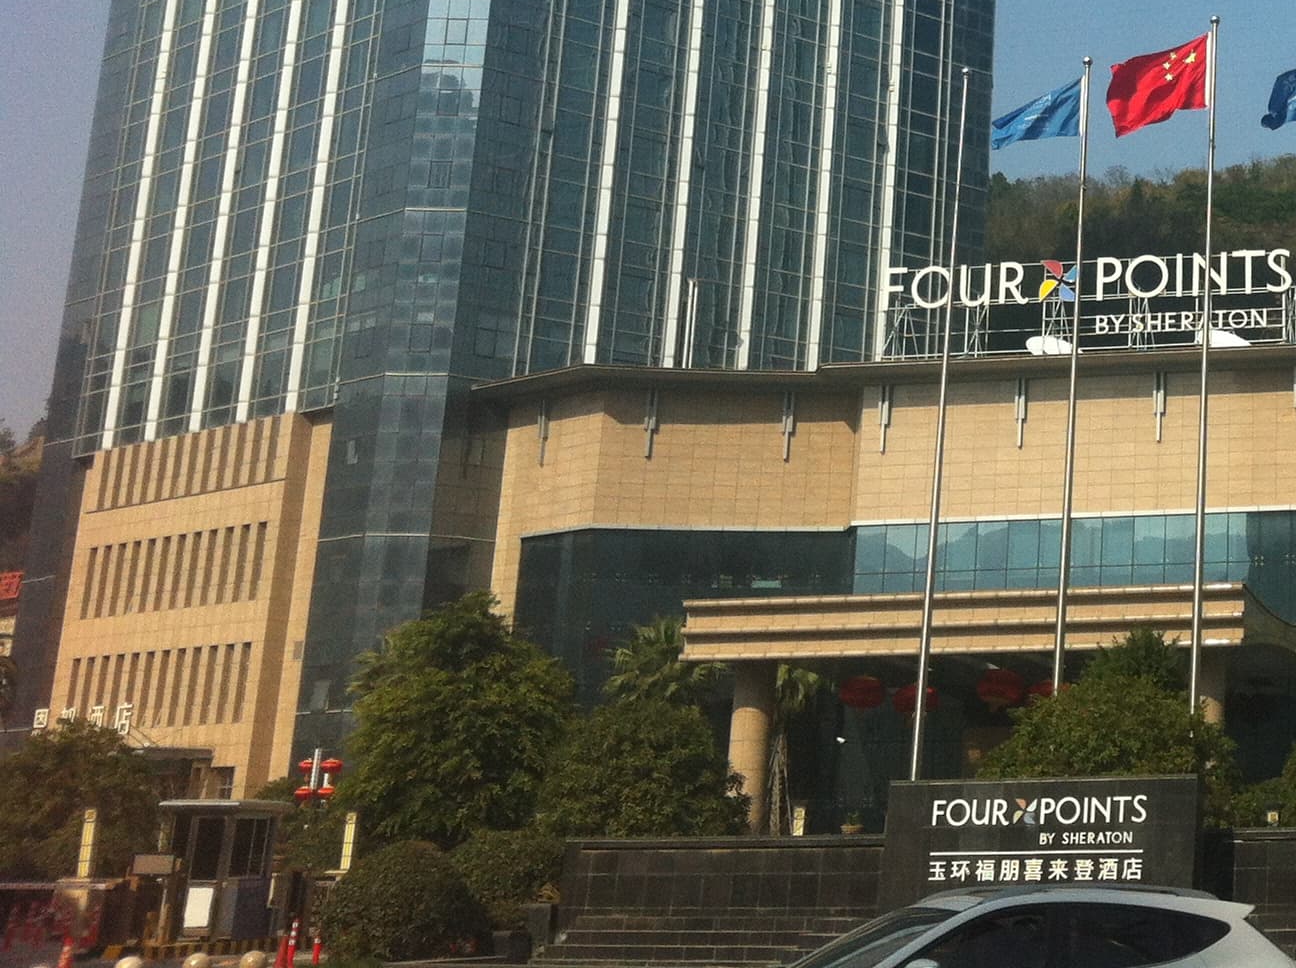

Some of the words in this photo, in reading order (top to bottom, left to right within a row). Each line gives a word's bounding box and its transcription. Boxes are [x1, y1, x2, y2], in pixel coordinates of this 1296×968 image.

[882, 261, 1029, 309] FOUR
[1095, 248, 1293, 300] POINTS
[1095, 314, 1120, 334] BY
[931, 798, 1009, 826] FOUR
[1039, 794, 1147, 825] POINTS
[1039, 832, 1054, 845] BY
[1061, 831, 1133, 844] SHERATON
[928, 858, 1143, 882] 玉环福朋喜来登酒店
